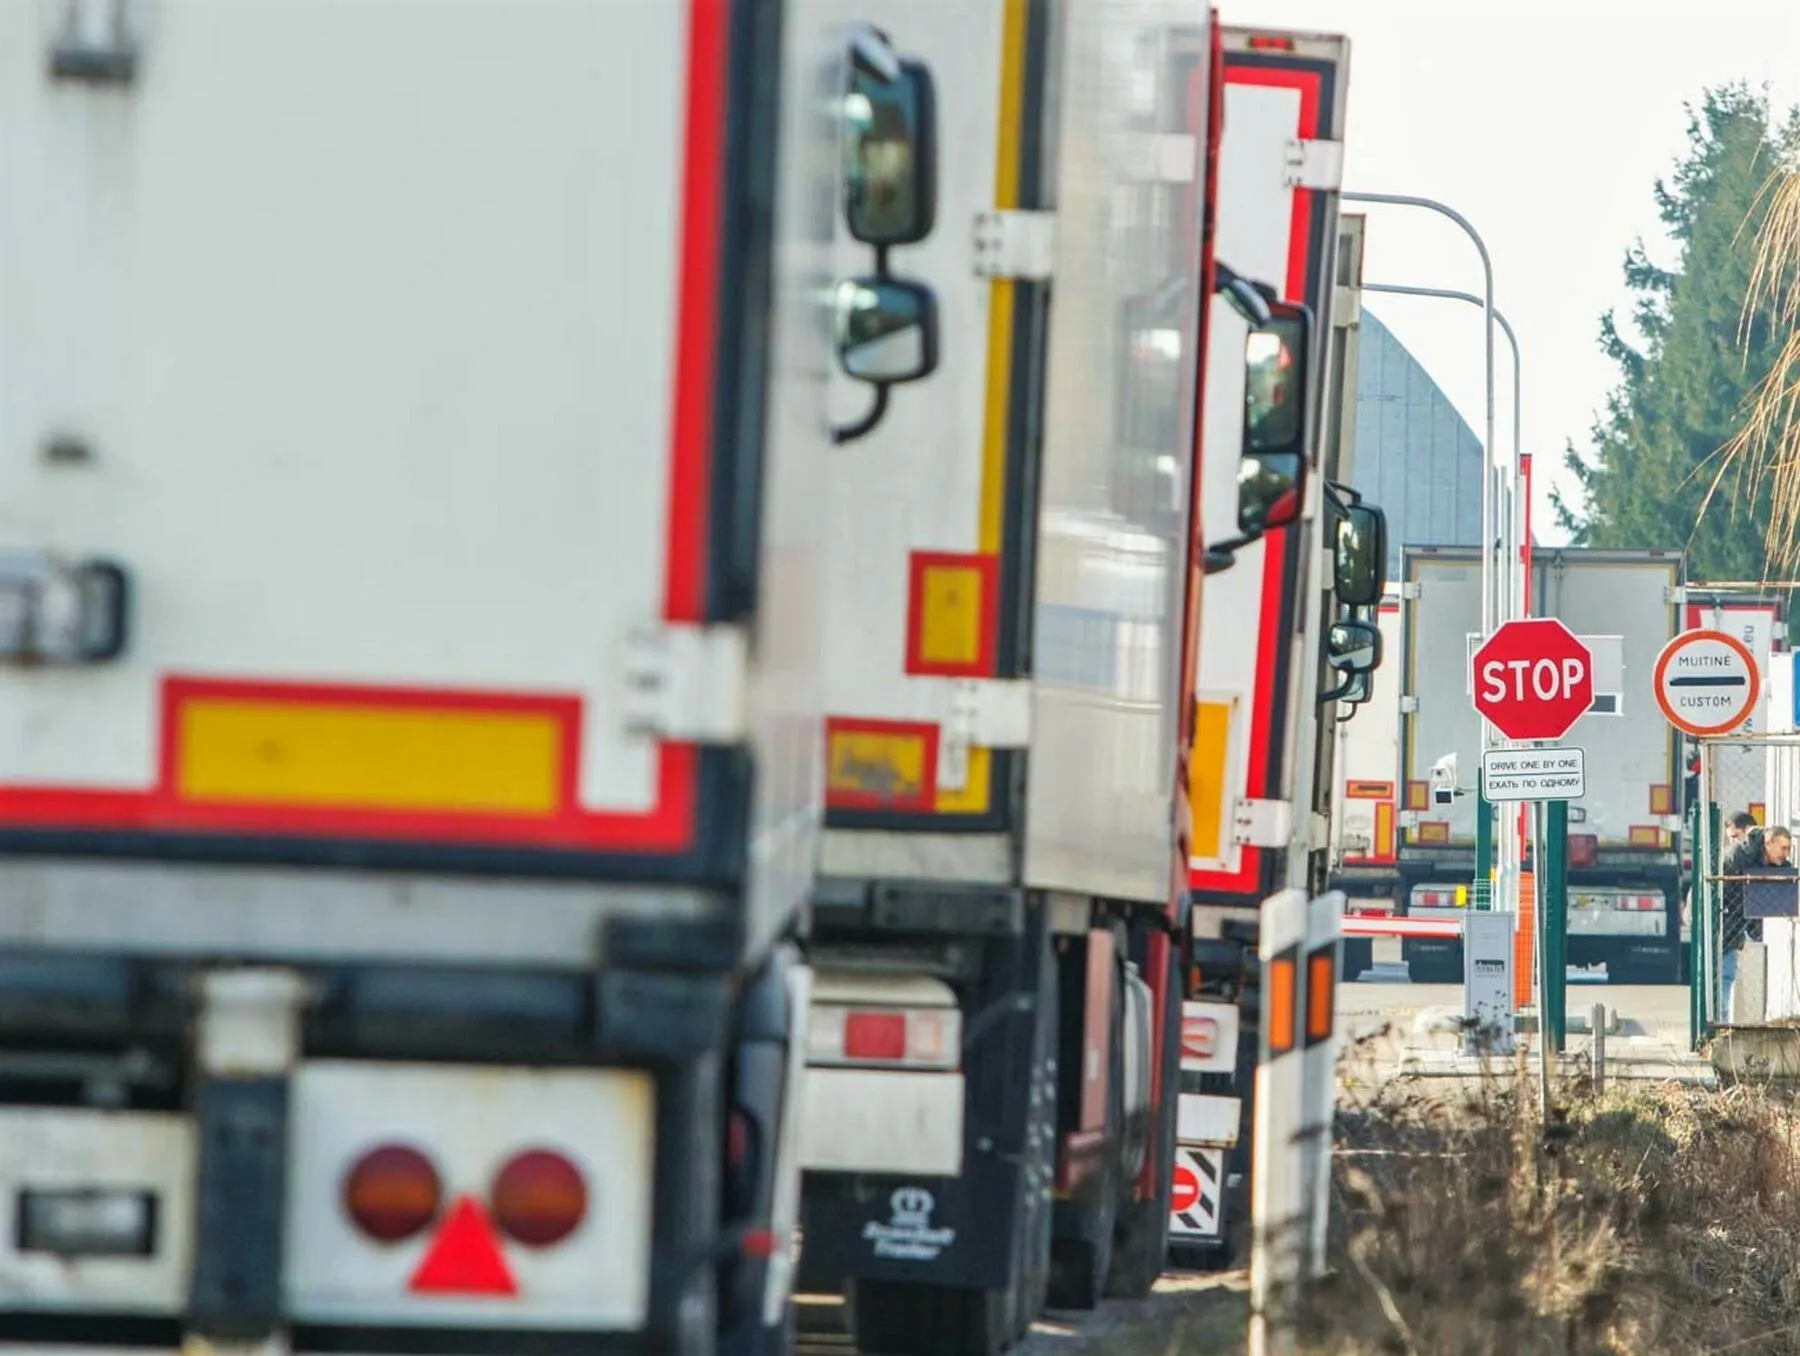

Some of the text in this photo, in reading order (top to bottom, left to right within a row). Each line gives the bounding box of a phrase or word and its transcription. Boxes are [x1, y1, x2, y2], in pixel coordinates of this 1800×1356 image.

[1678, 654, 1732, 667] MUITINĖ
[1482, 658, 1585, 703] STOP
[1680, 696, 1732, 708] CUSTOM
[1490, 759, 1577, 771] DRIVE ONE BY ONE
[1489, 778, 1580, 789] ЕХАТЬ ПО ОДНОМУ
